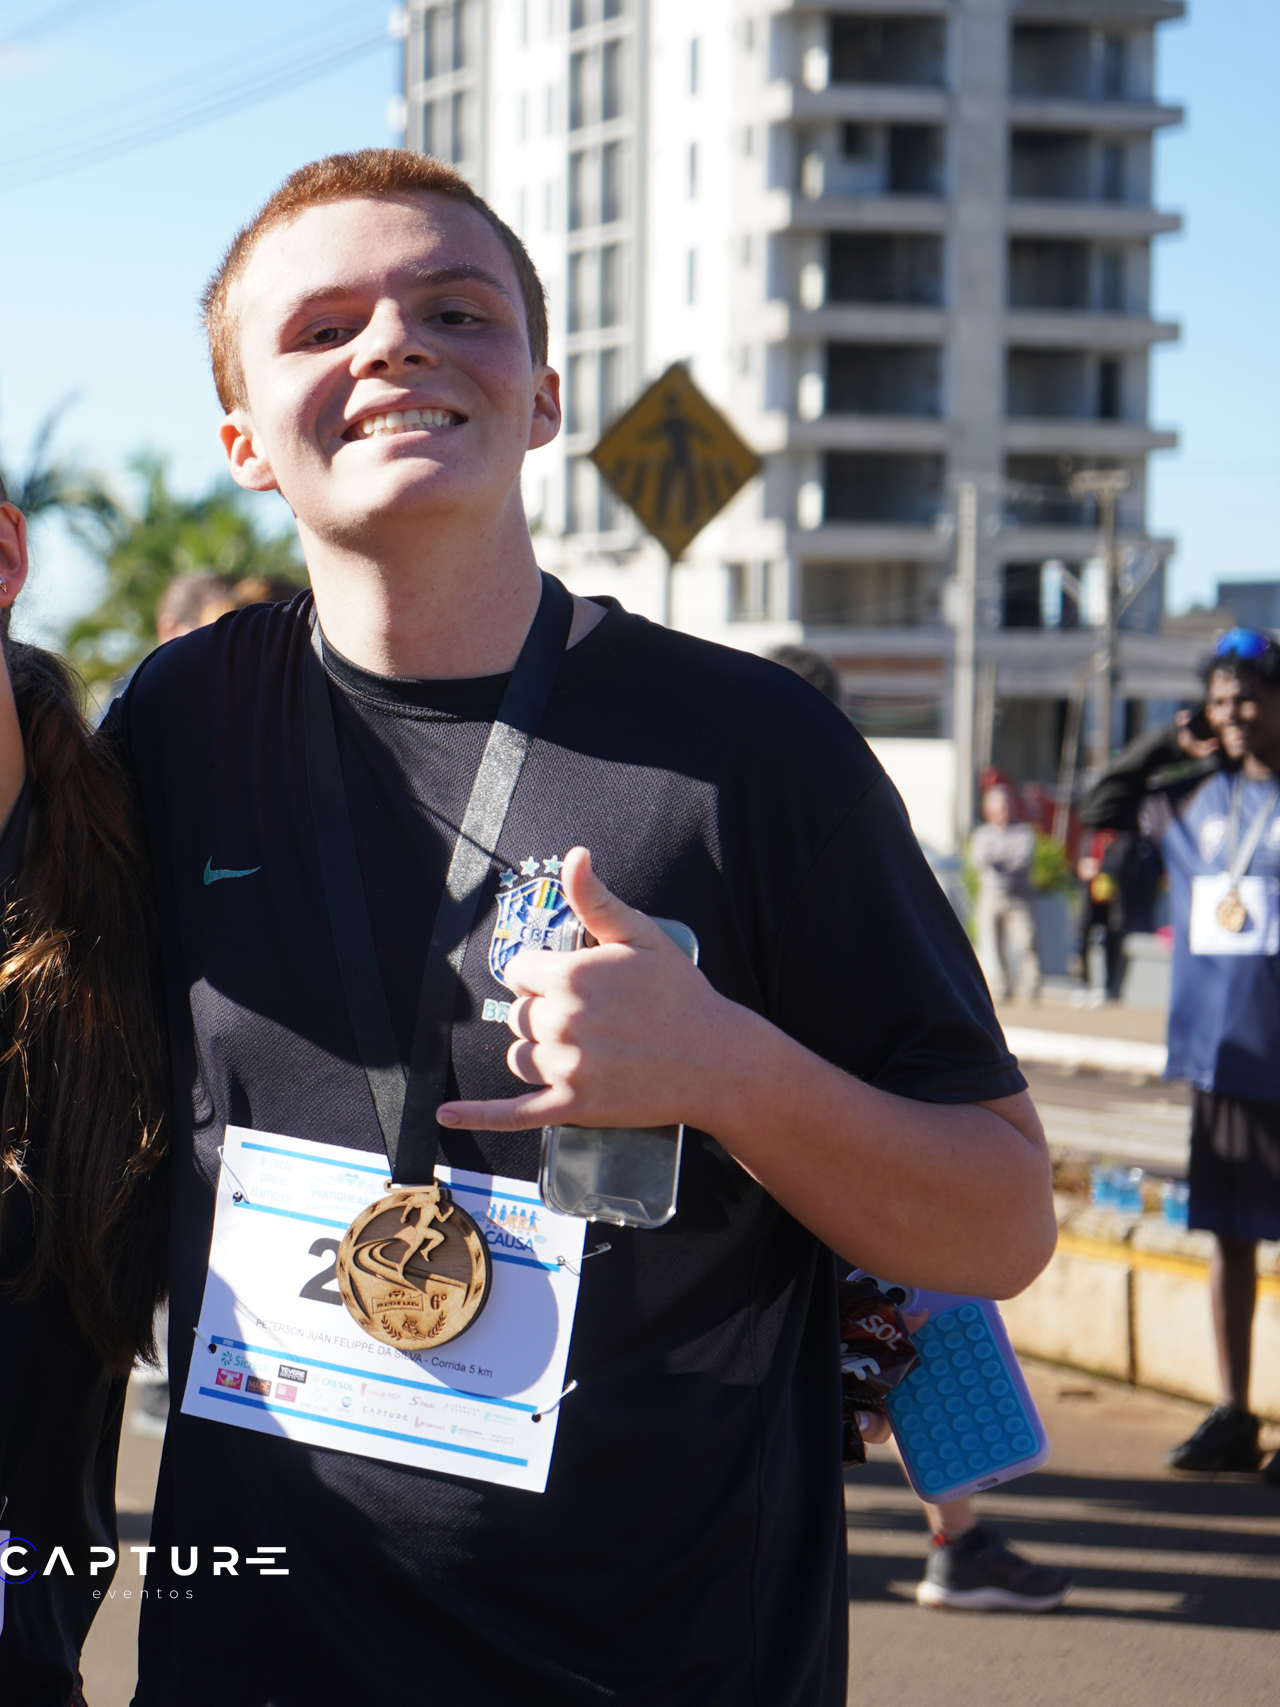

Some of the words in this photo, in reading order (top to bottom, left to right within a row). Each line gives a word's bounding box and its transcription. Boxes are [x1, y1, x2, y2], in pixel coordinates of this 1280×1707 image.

[519, 925, 554, 943] CBF
[269, 1159, 293, 1172] EDIÇÃO
[260, 1172, 288, 1187] CORRIDA
[250, 1186, 293, 1205] BENEFICENTE
[311, 1190, 355, 1203] PRATIQUE
[484, 1231, 535, 1253] CAUSA
[256, 1318, 305, 1338] PETERSON
[305, 1330, 332, 1344] JUAN
[334, 1336, 375, 1353] FELIPPE
[377, 1345, 392, 1357] DA
[394, 1348, 422, 1364] SILVA
[431, 1357, 467, 1373] Corrida
[468, 1364, 476, 1375] 5
[477, 1366, 494, 1378] km
[234, 1355, 270, 1373] Sicredi
[280, 1366, 306, 1378] TEVERE
[322, 1378, 354, 1391] CRESOL
[362, 1406, 409, 1421] CAPTURE
